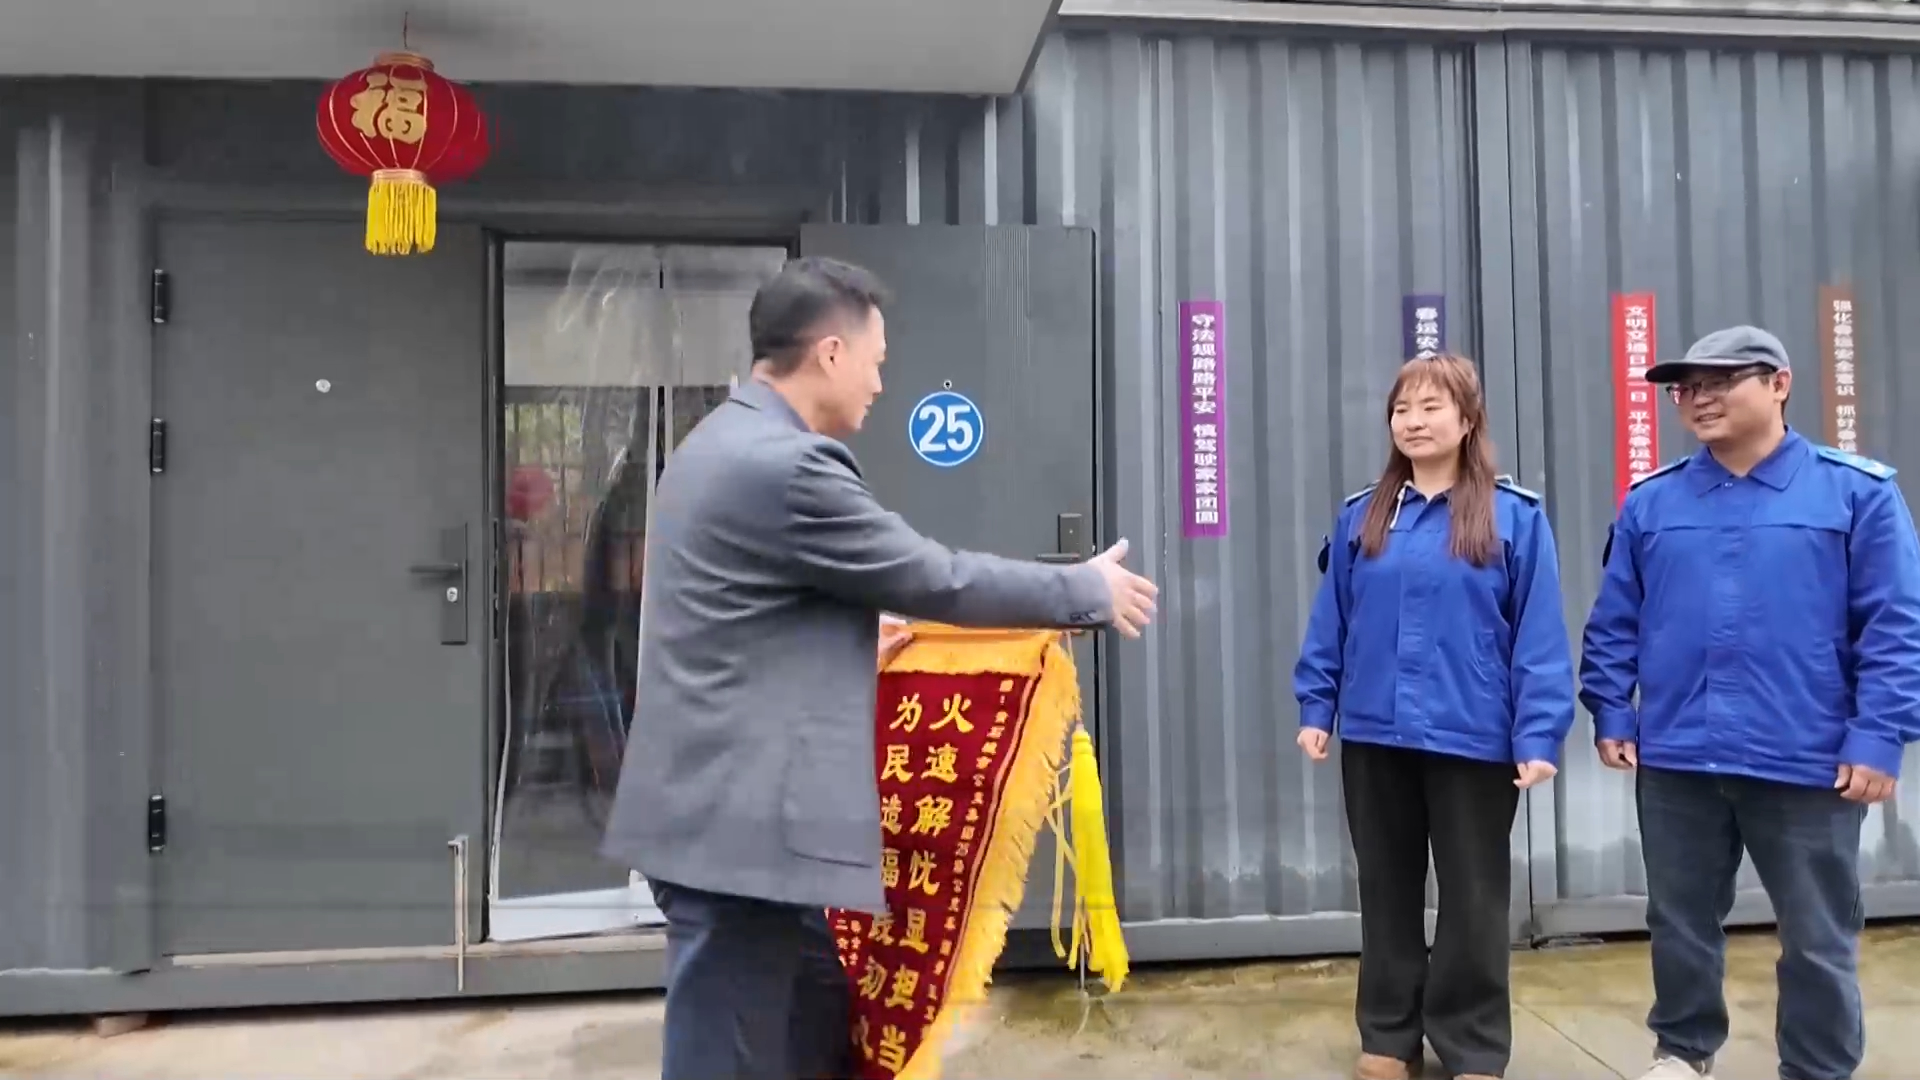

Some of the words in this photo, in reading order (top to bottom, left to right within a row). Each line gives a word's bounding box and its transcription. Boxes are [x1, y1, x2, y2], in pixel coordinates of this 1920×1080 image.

[350, 72, 427, 144] 福
[1192, 313, 1216, 414] 守法规路路平安
[919, 404, 973, 452] 25
[1193, 424, 1218, 524] 慎驾驶家家团圆
[878, 693, 975, 1073] 火速解忧显担当
